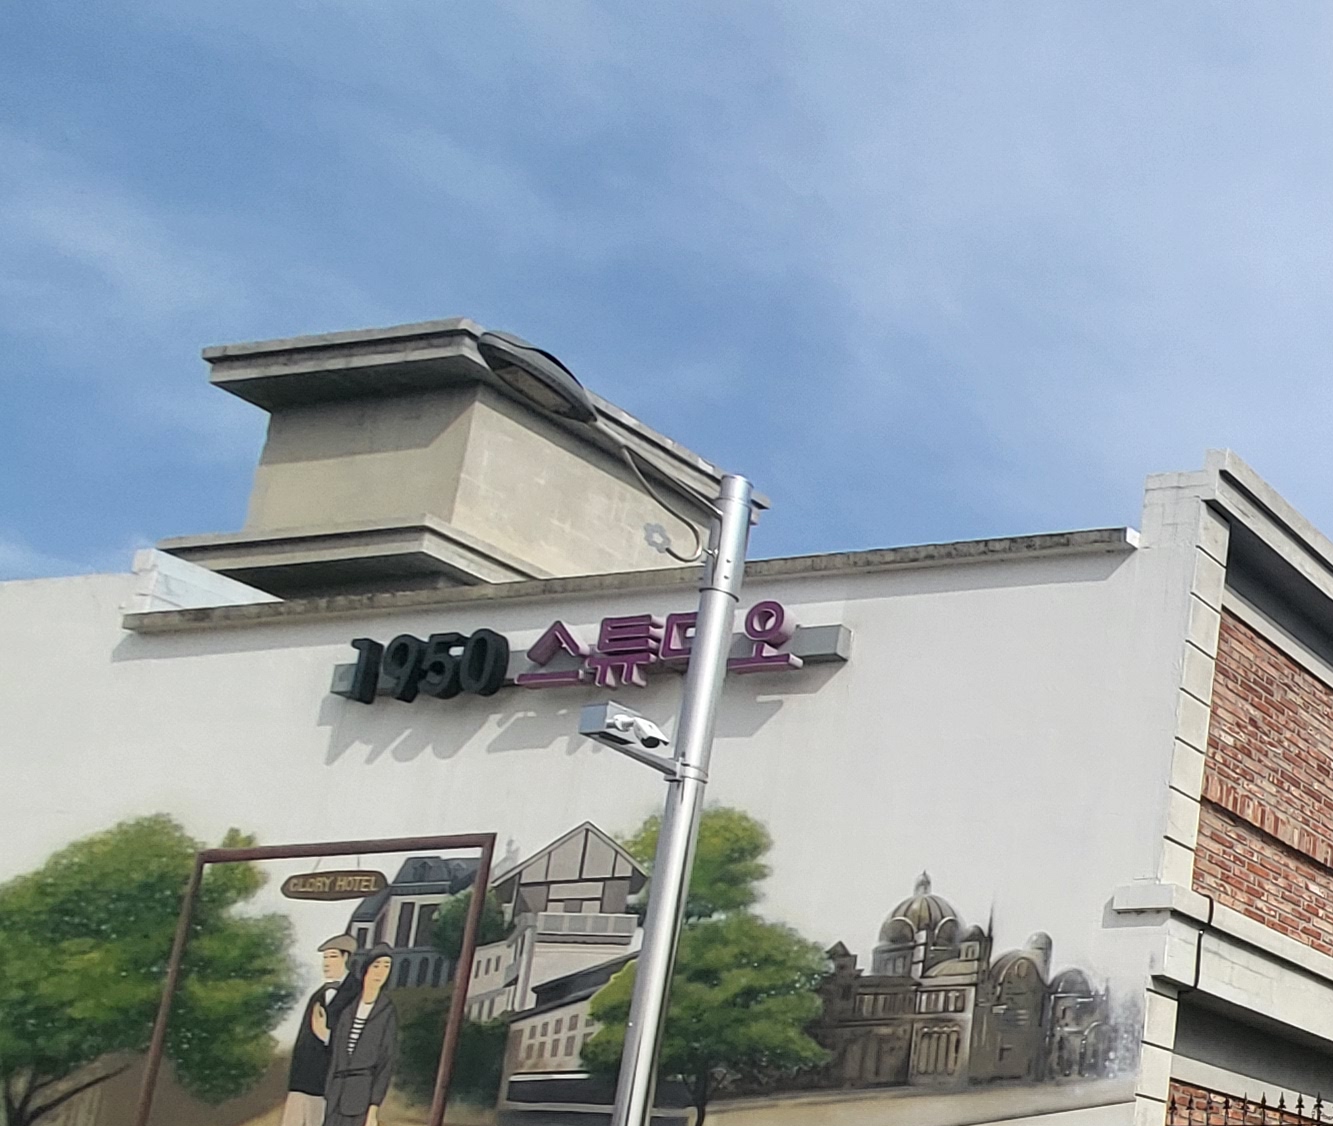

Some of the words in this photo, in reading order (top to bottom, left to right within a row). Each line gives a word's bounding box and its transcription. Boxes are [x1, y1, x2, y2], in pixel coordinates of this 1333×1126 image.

[351, 628, 510, 705] 1950
[290, 877, 333, 892] GLORY
[335, 876, 379, 892] HOTEL
